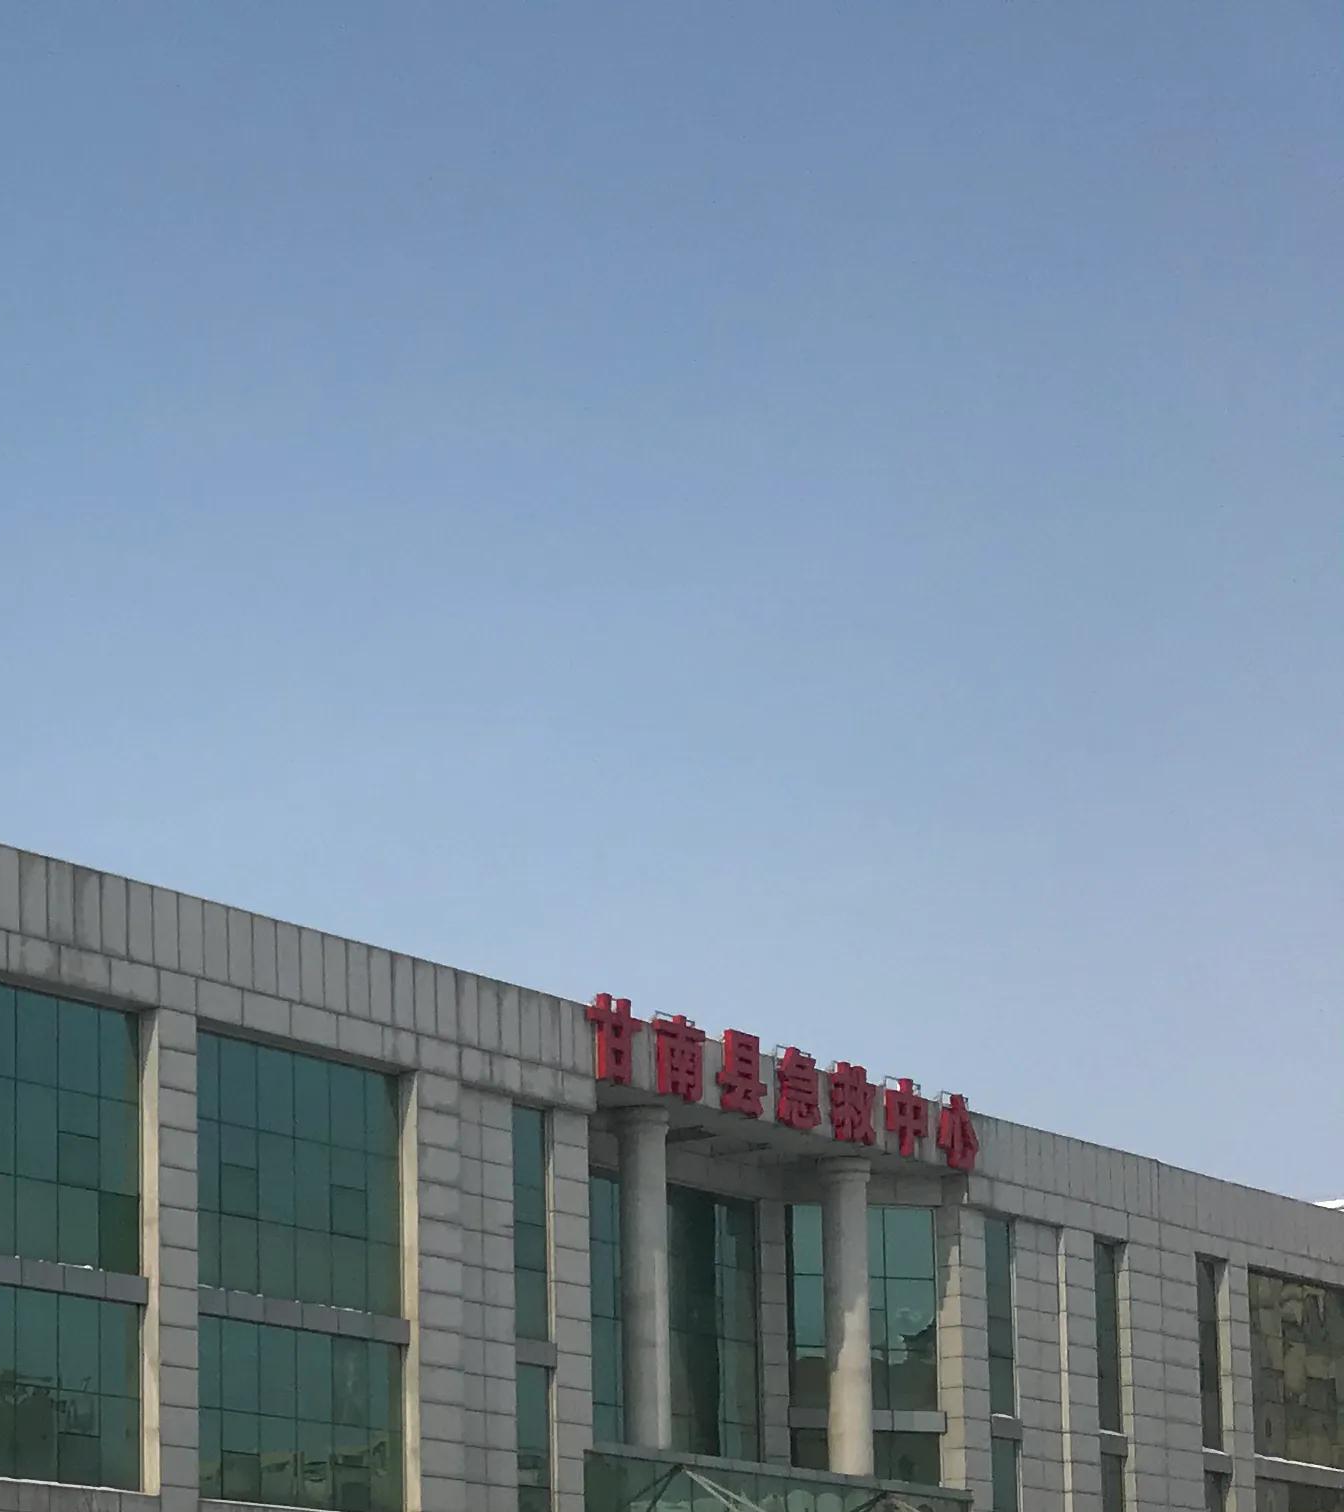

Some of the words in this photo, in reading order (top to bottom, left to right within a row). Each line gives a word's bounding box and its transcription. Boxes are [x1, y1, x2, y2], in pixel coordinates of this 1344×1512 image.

[585, 993, 980, 1171] 甘南县急救中心
